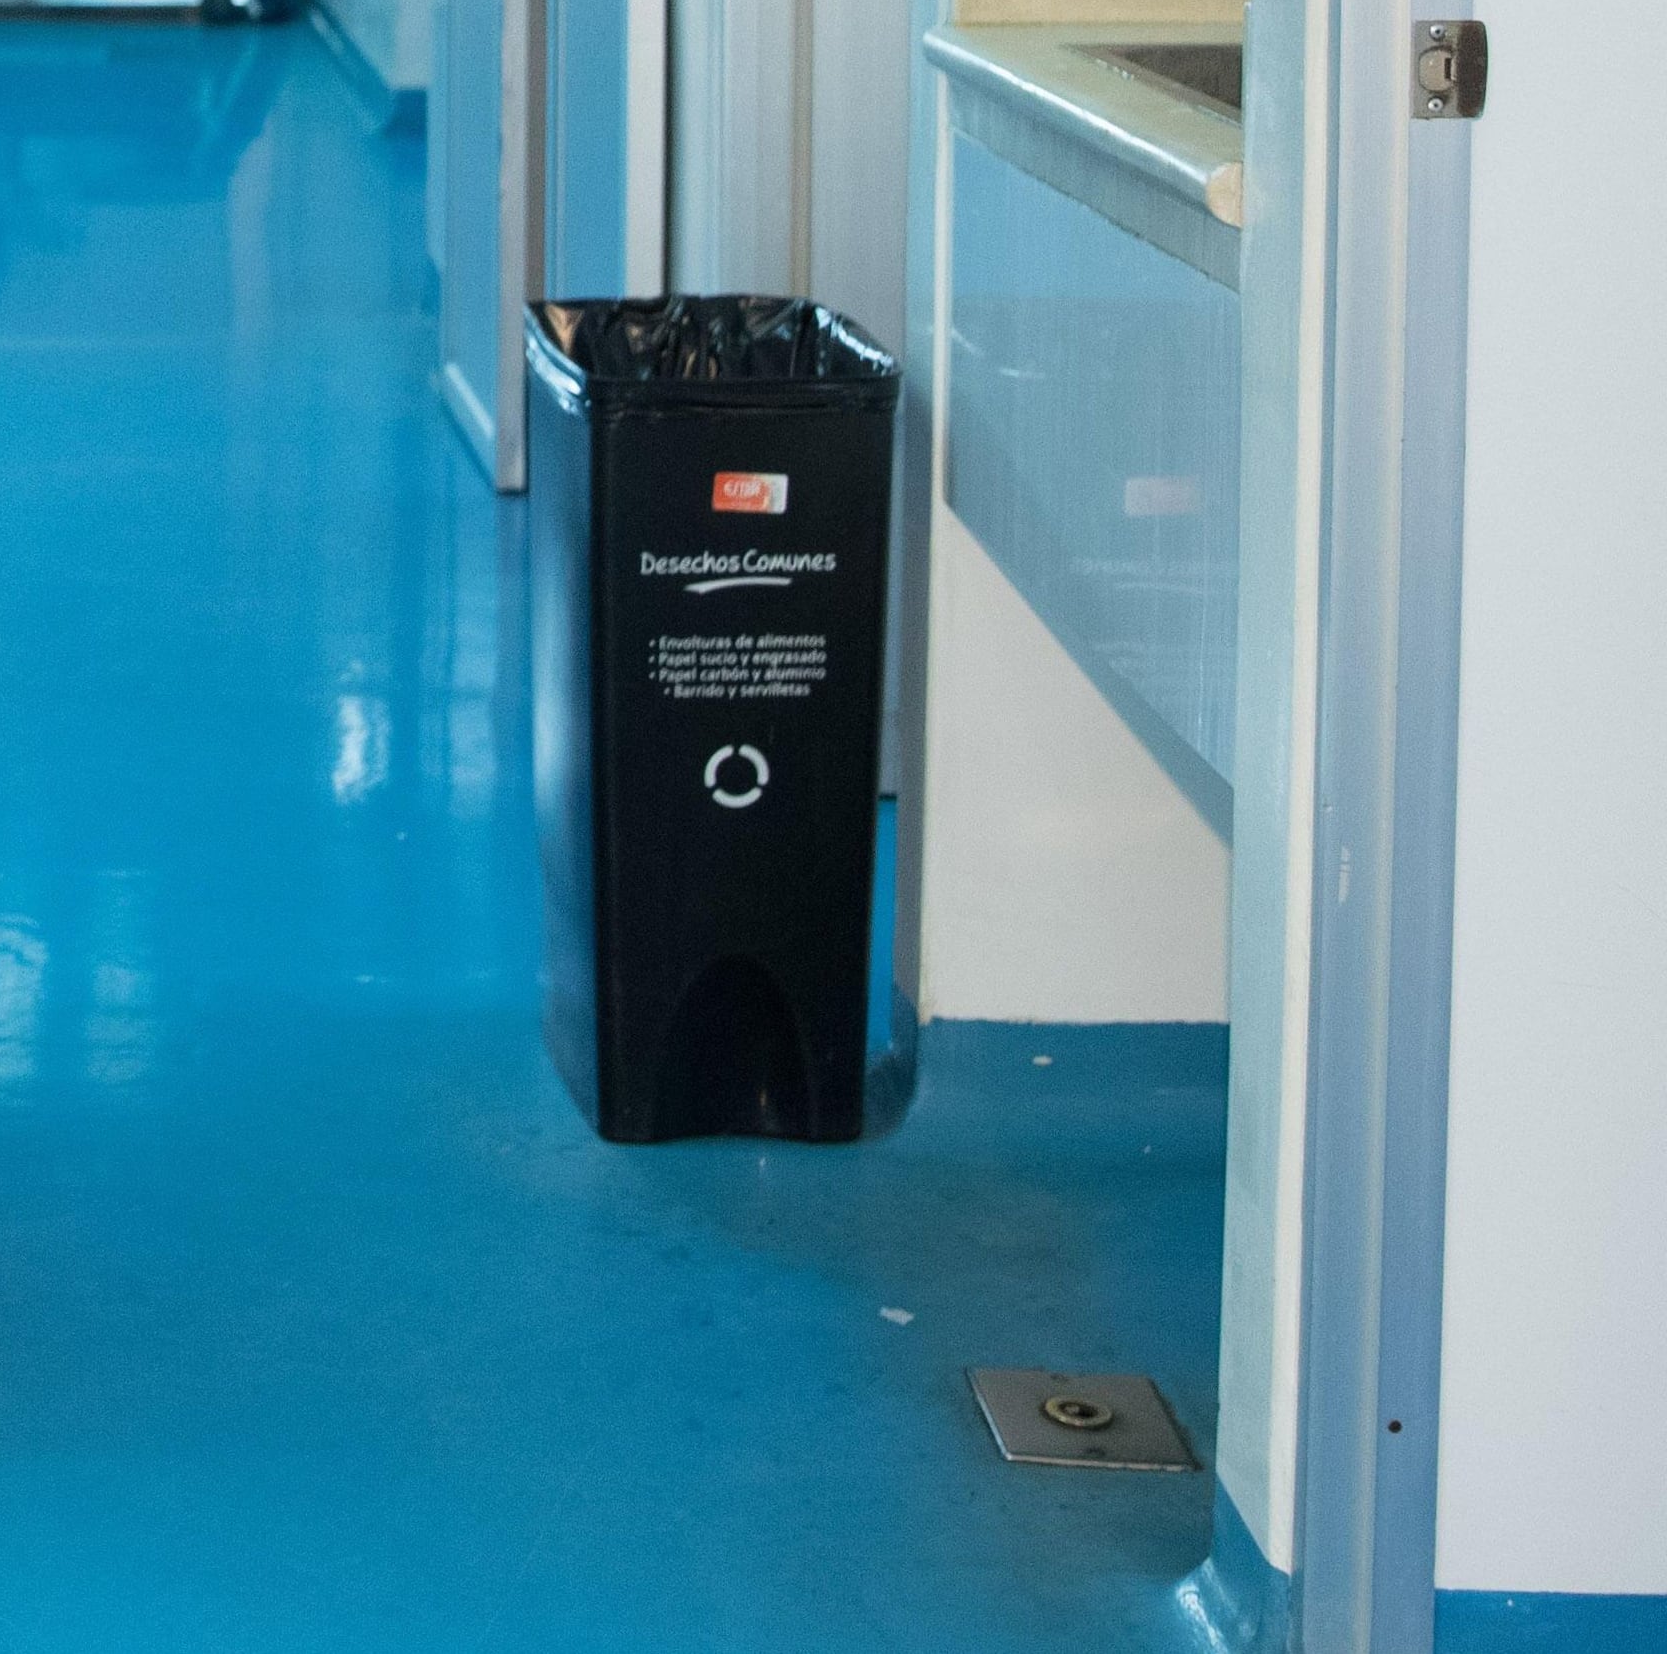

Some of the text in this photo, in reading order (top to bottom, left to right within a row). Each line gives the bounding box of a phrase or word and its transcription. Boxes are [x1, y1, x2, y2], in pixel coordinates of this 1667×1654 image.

[639, 549, 837, 576] Desechos Comunes
[659, 633, 827, 650] Envolturas de alimentos
[659, 649, 827, 667] Papel sucio y engrasado
[659, 665, 827, 683] Papel carbón y aluminio
[673, 683, 811, 699] Barrido y servilletas
